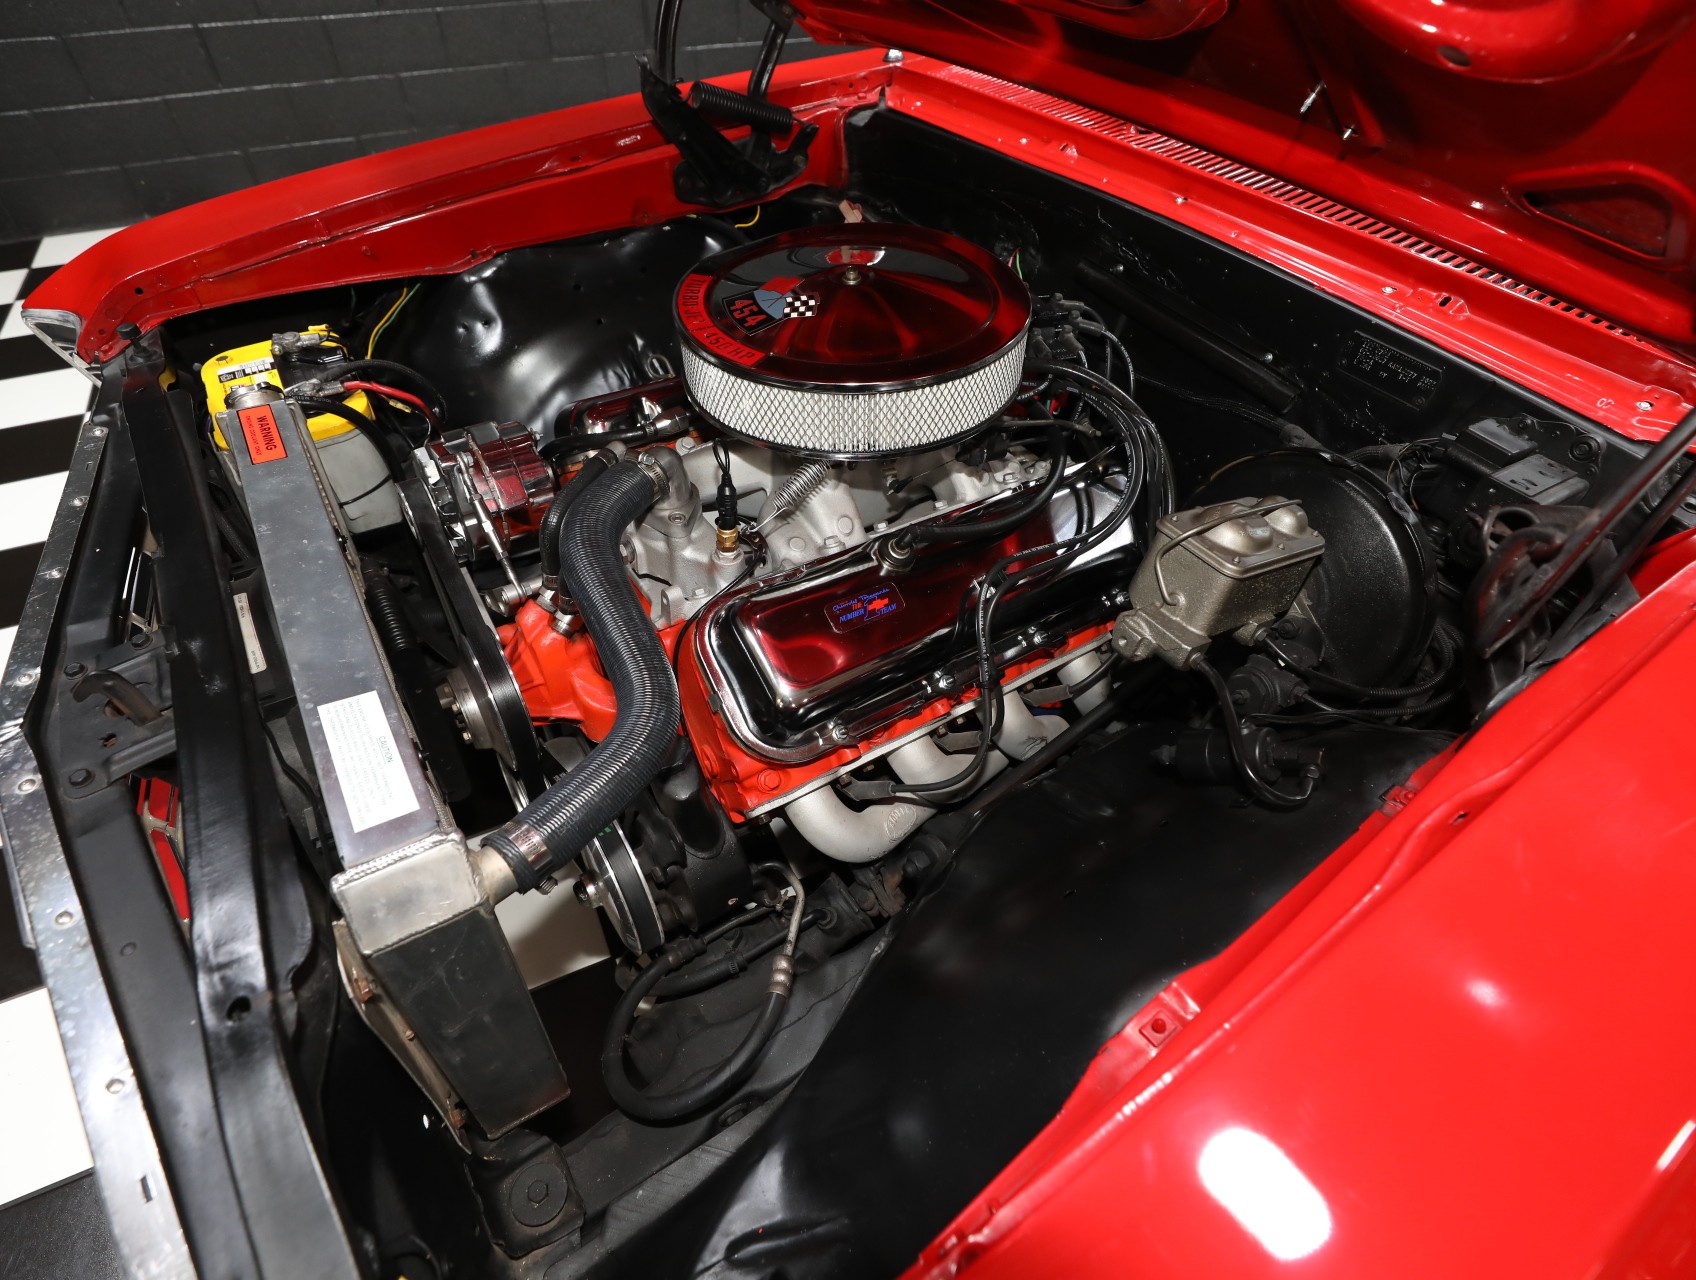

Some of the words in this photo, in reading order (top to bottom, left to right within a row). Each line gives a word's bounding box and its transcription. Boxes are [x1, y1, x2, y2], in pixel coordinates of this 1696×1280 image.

[683, 278, 705, 324] TURBO-JET
[704, 332, 733, 350] 450
[727, 348, 755, 360] HP
[730, 300, 768, 328] 454
[256, 416, 277, 450] WARNING
[840, 608, 864, 623] NUMBER
[880, 603, 897, 615] TEAM
[852, 602, 862, 610] THE
[378, 736, 394, 762] CAUTION
